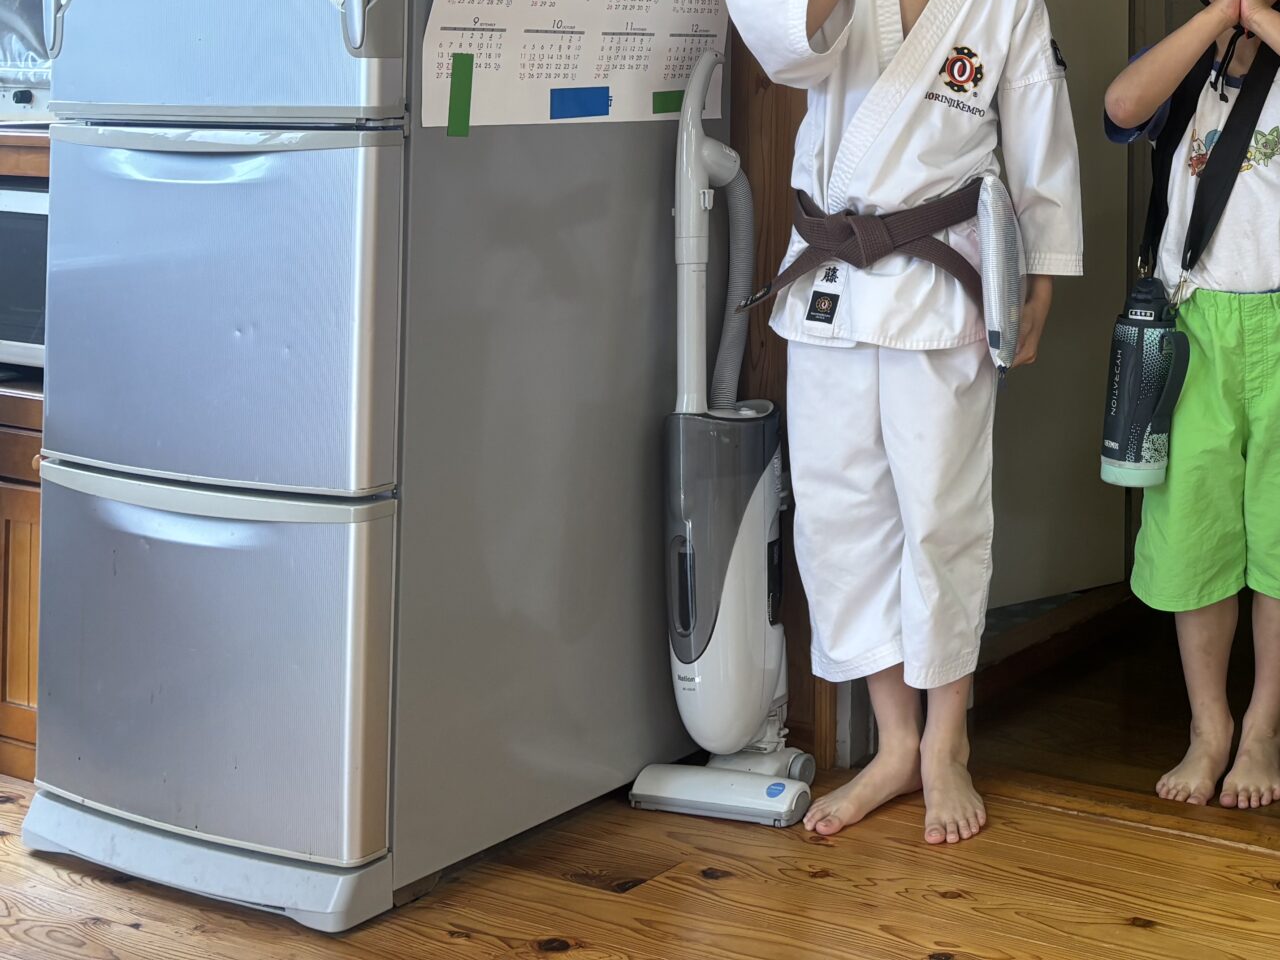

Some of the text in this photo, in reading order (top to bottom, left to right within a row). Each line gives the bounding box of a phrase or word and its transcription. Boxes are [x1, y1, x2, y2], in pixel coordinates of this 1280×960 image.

[473, 17, 480, 26] 9
[552, 20, 562, 28] 10
[626, 22, 634, 31] 11
[691, 24, 698, 32] 12
[821, 266, 839, 283] 藤
[1110, 350, 1122, 416] HYDRATION
